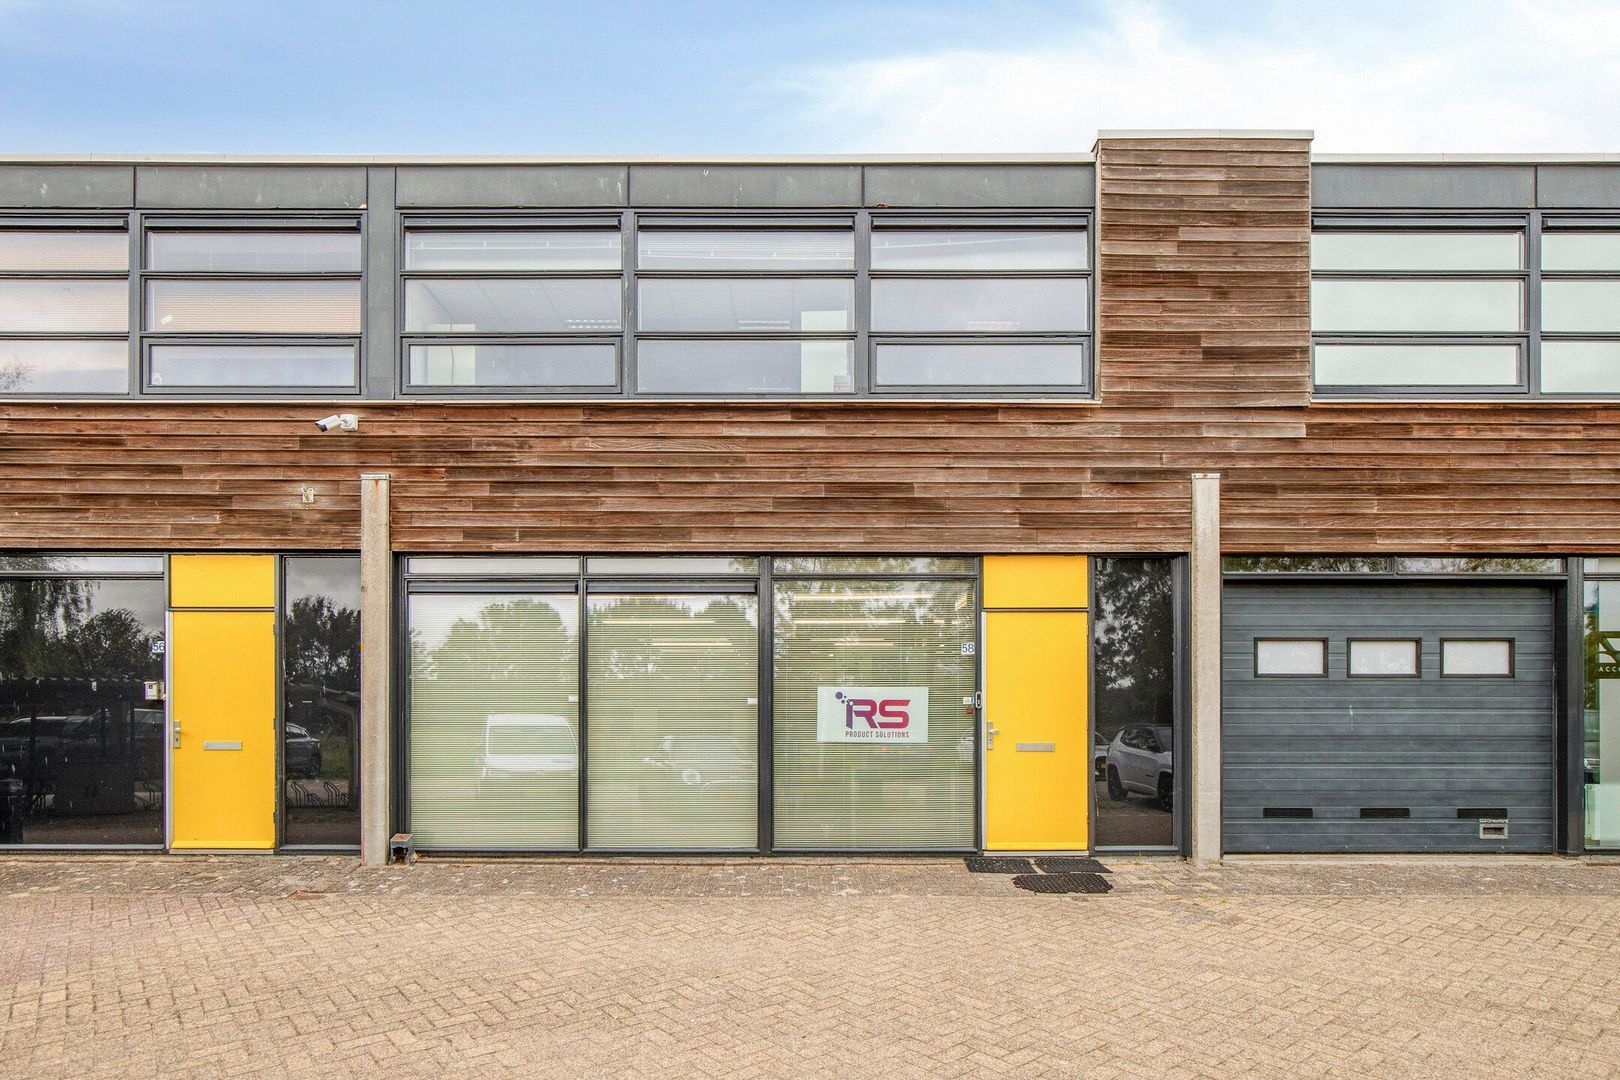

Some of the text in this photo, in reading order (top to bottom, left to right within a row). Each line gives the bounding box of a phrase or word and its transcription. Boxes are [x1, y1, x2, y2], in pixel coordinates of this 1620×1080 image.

[153, 643, 164, 652] 56
[962, 643, 975, 653] 58
[846, 699, 910, 729] RS
